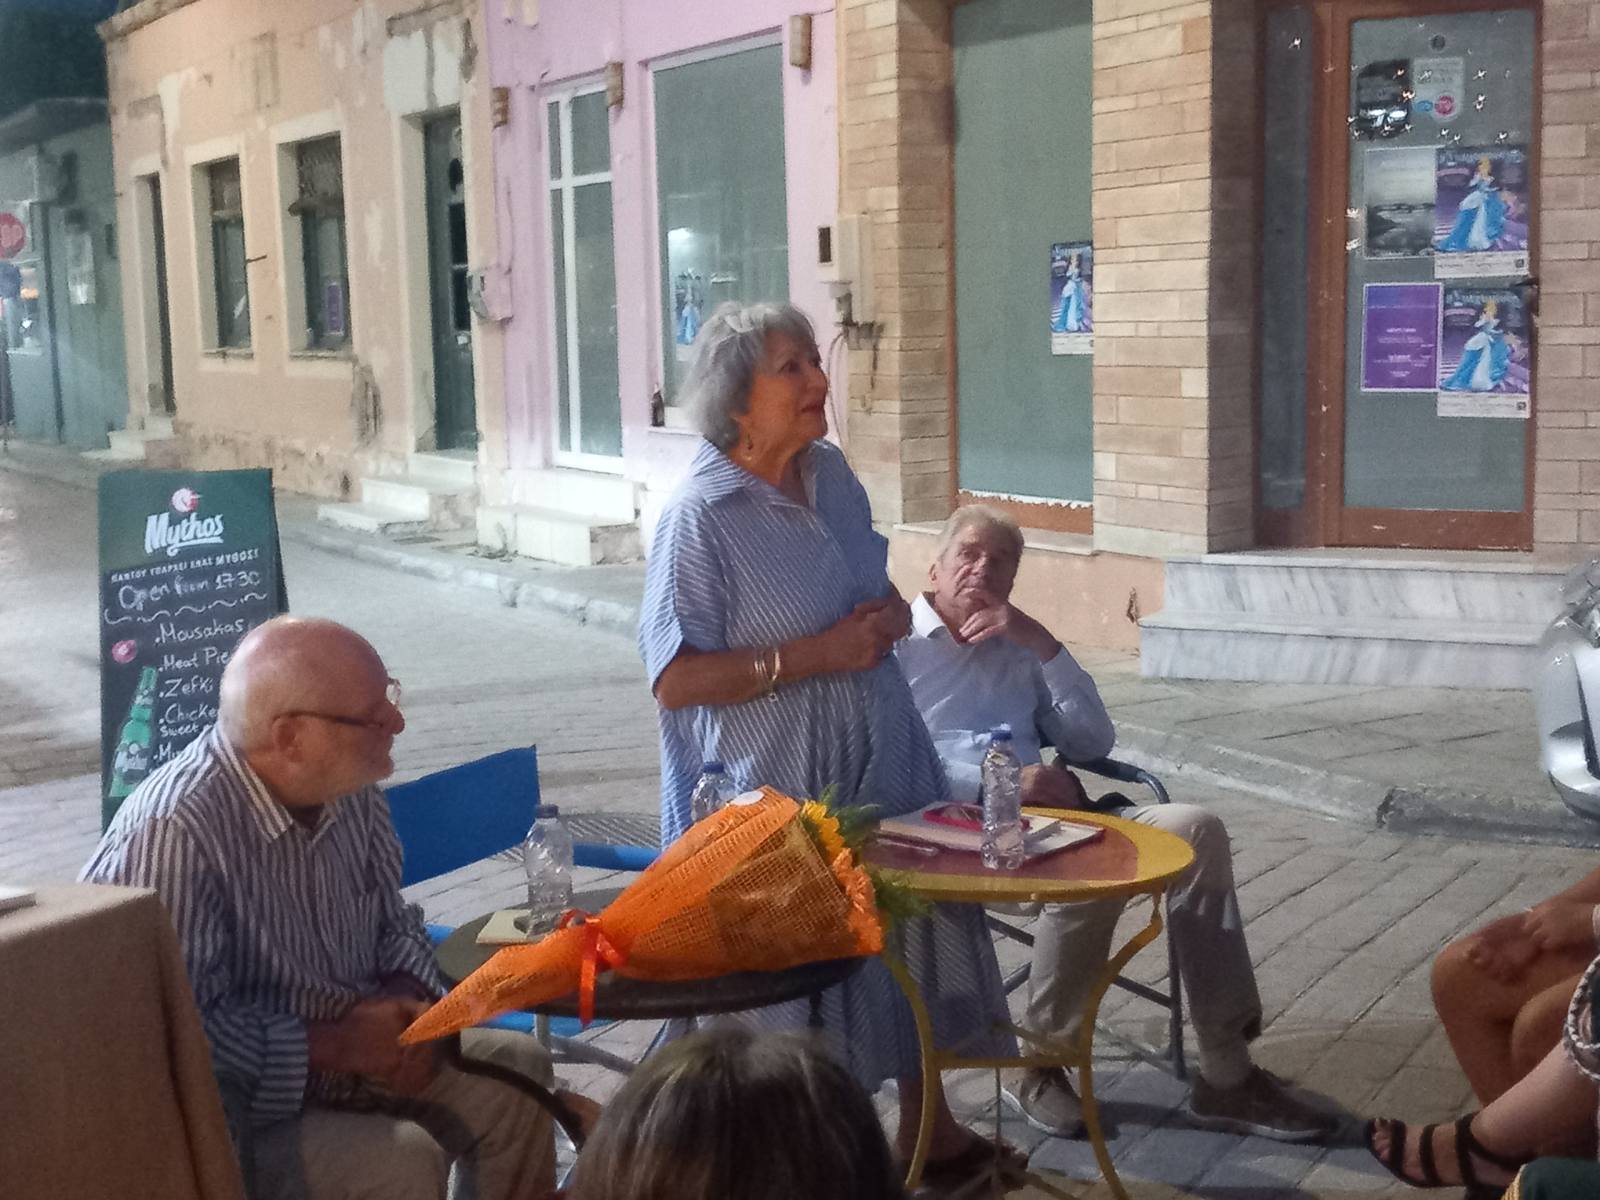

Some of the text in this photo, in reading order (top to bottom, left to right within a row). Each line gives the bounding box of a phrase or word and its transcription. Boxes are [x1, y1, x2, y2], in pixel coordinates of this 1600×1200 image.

[144, 512, 224, 557] Mythos
[119, 582, 171, 612] Open
[159, 618, 244, 644] Mousakas
[163, 651, 200, 669] Meat
[164, 702, 218, 724] Chicke
